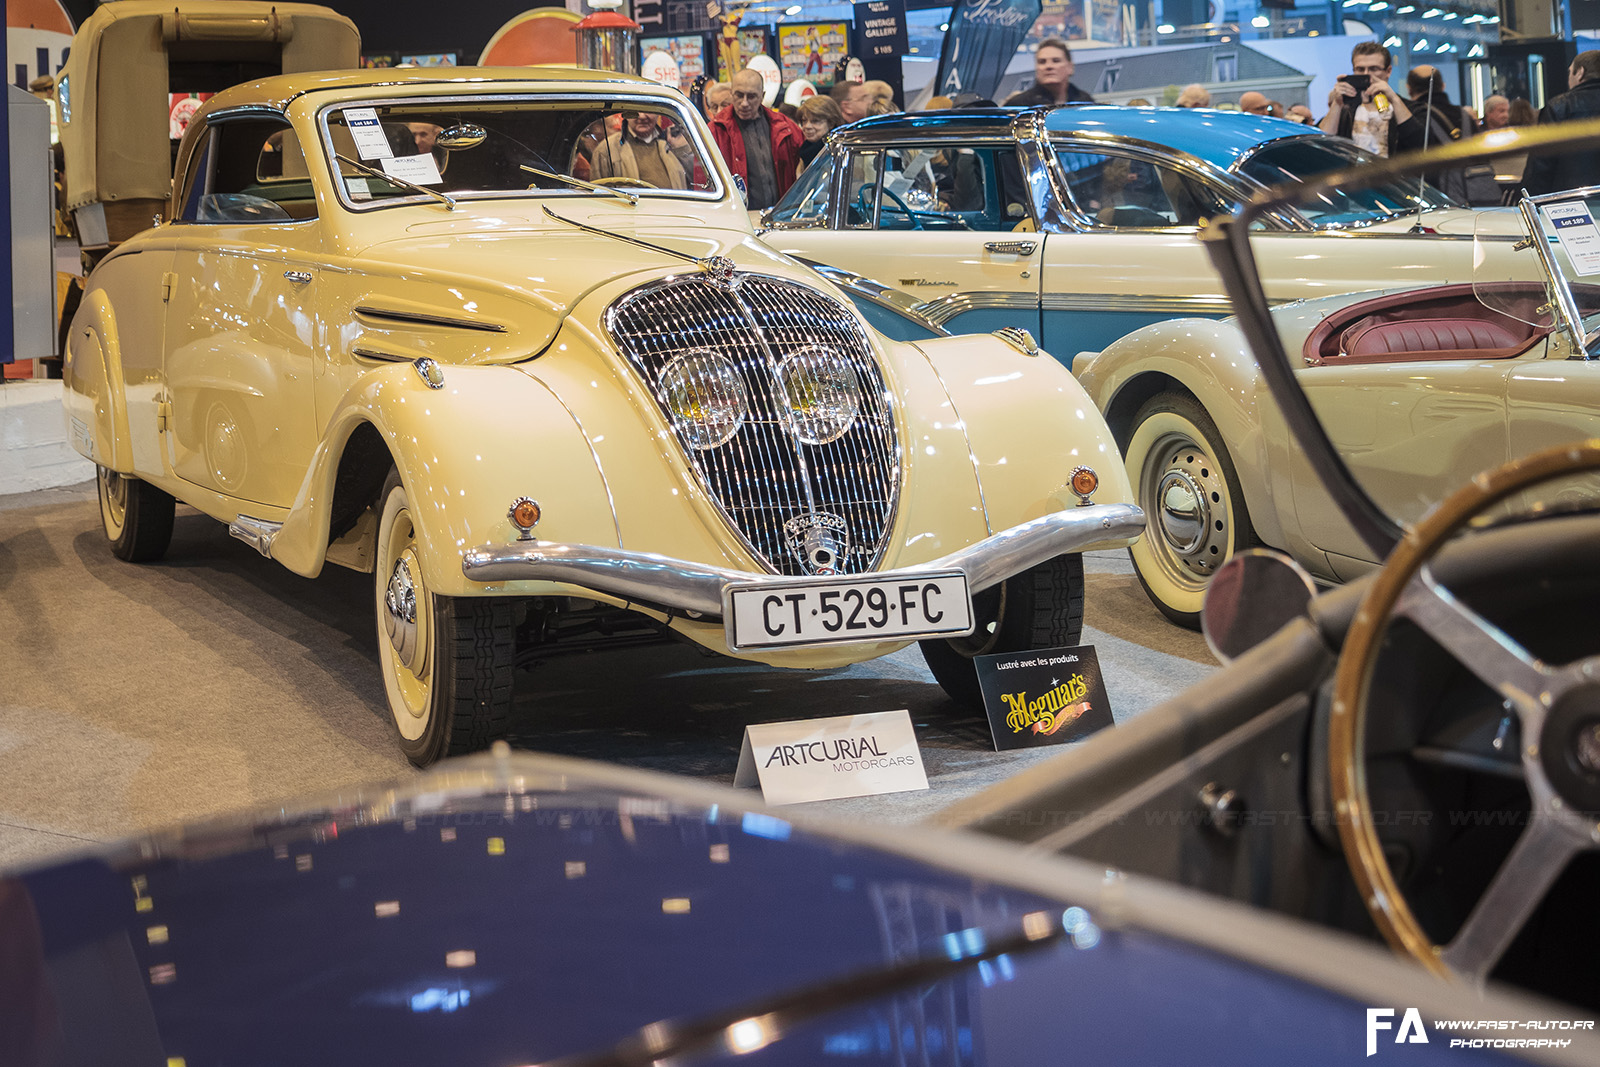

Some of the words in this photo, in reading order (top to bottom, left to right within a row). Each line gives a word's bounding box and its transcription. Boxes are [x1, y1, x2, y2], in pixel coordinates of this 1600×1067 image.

[864, 17, 896, 28] VINTAGE
[865, 27, 897, 38] GALLERY
[996, 660, 1020, 670] Lustré
[1020, 659, 1037, 668] avec
[1037, 657, 1049, 666] les
[1049, 654, 1079, 667] produits
[1000, 673, 1087, 733] Meguiar's
[833, 756, 915, 772] MOTORCARS
